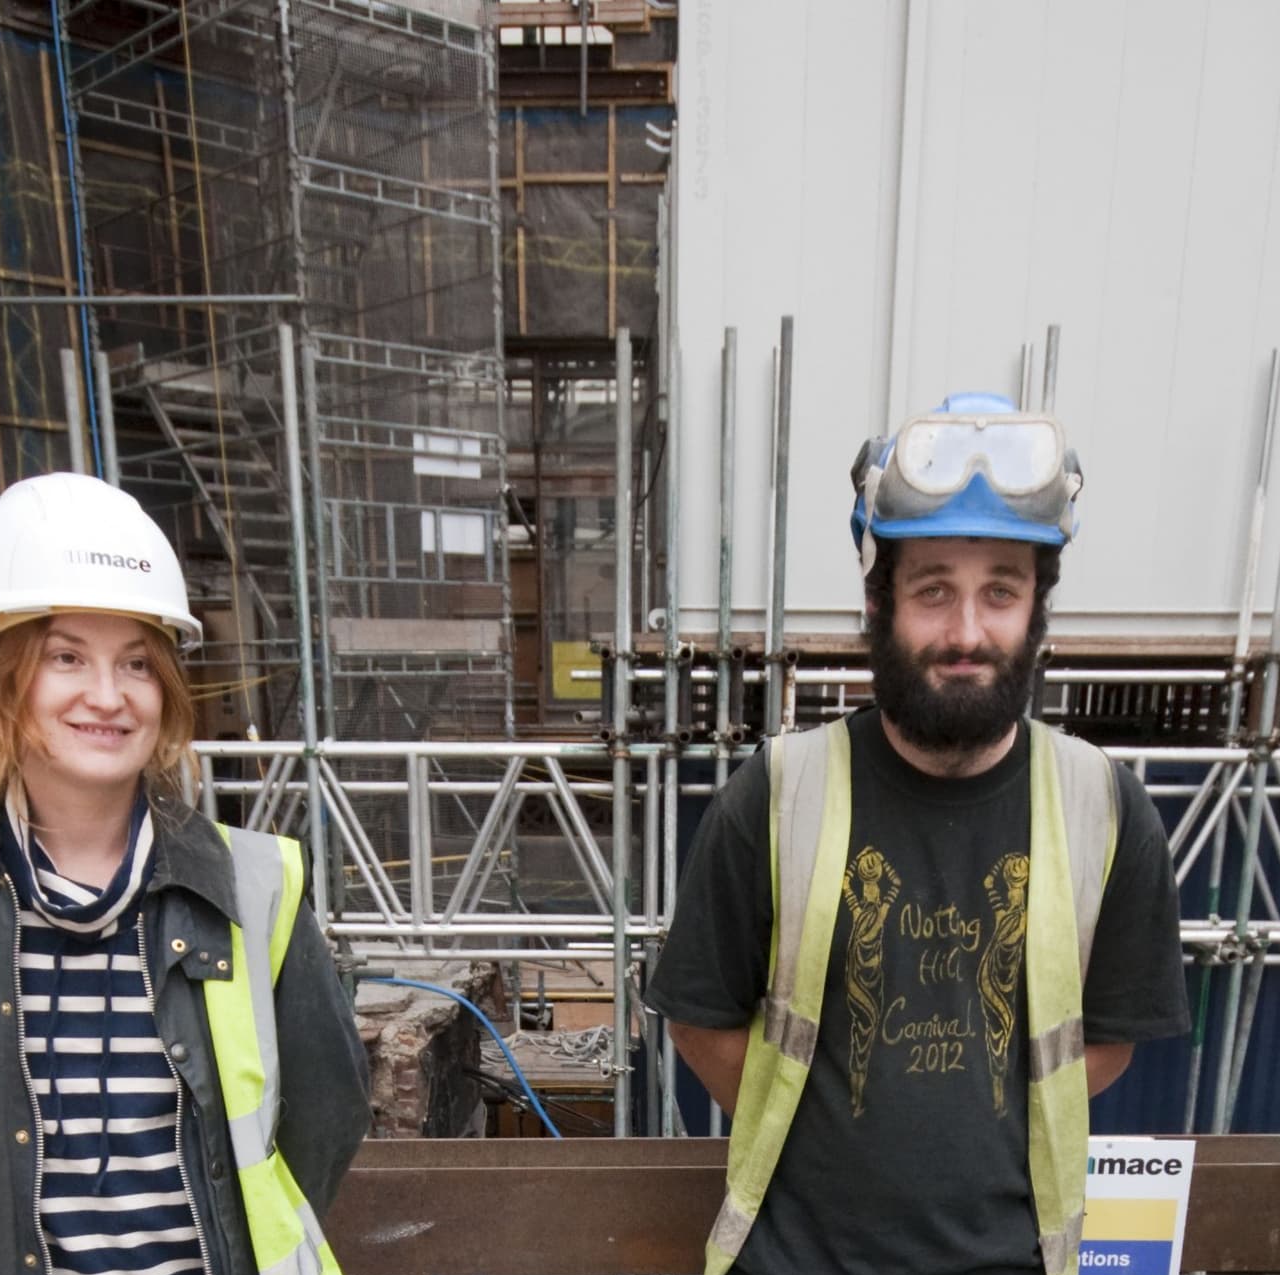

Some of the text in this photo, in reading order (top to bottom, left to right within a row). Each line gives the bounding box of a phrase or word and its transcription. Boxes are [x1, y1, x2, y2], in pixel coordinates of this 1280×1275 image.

[89, 550, 152, 573] mace
[900, 903, 981, 951] Notting
[920, 947, 964, 985] Hill
[882, 996, 976, 1045] Carnival
[906, 1041, 966, 1073] 2012
[1097, 1157, 1183, 1175] mace
[1077, 1251, 1131, 1267] tions
